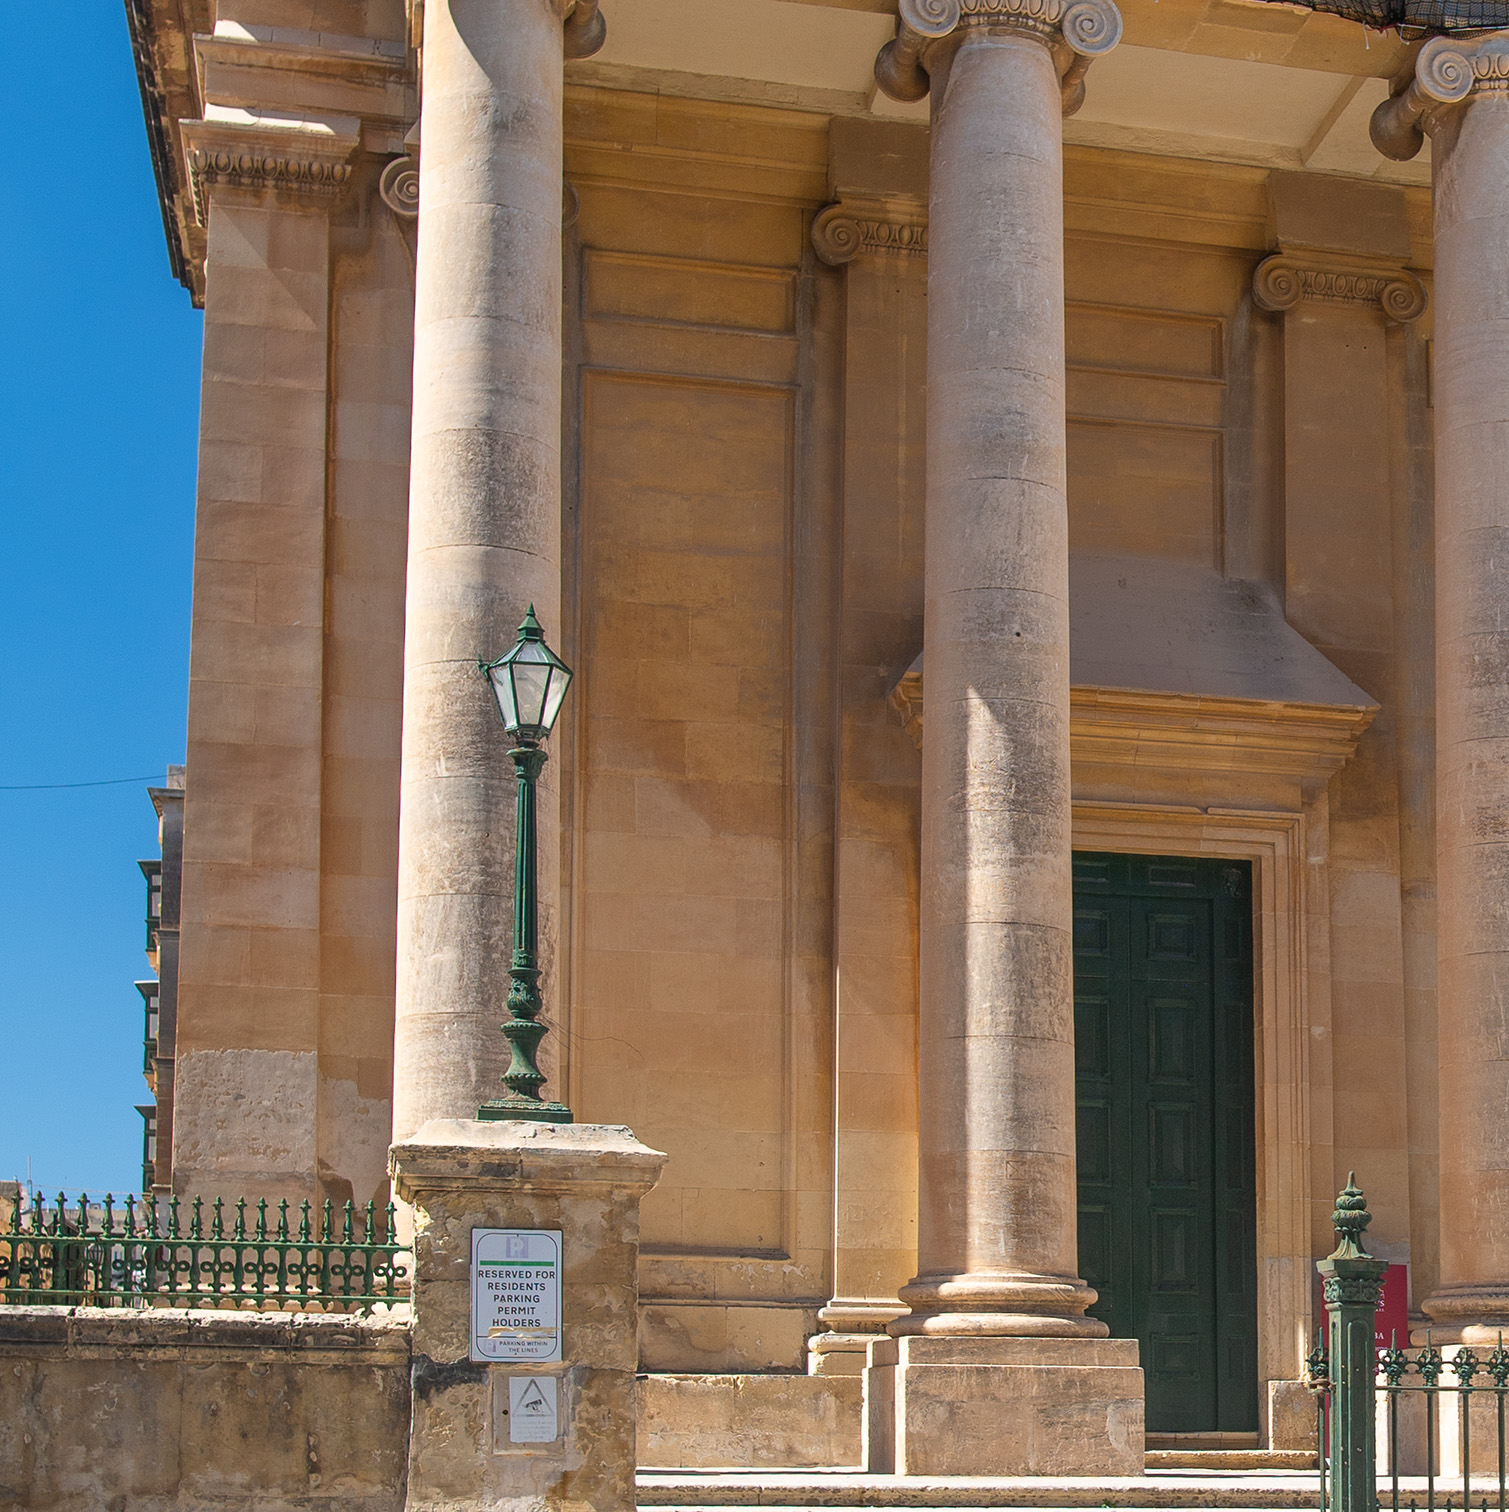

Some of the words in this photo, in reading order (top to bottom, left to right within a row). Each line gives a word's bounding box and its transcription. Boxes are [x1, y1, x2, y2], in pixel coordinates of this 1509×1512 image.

[478, 1269, 532, 1279] RESERVED
[535, 1270, 556, 1280] FOR
[487, 1282, 546, 1291] RESIDENTS
[493, 1294, 541, 1304] PARKING
[497, 1306, 536, 1316] PERMIT
[492, 1318, 541, 1328] HOLDERS
